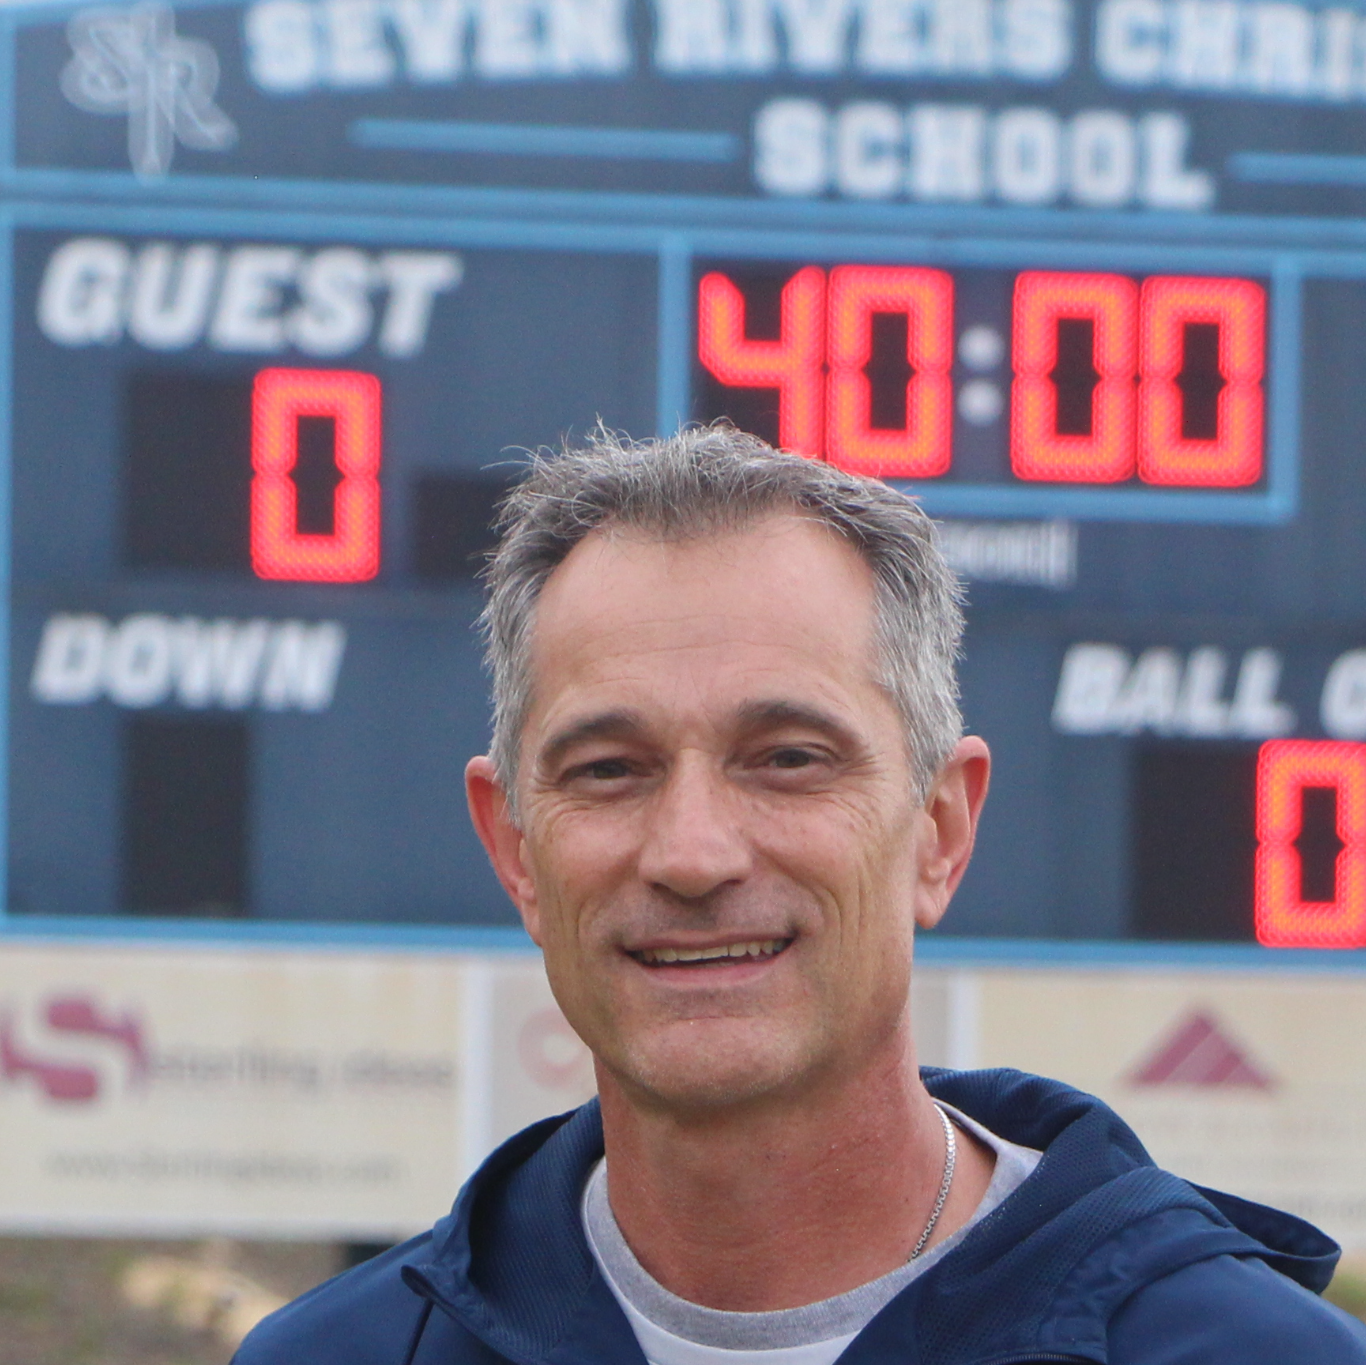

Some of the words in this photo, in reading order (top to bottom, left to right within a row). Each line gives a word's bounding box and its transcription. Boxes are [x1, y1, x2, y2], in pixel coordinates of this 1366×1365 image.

[245, 0, 630, 91] SEVEN
[653, 0, 1073, 79] RIVERS
[753, 96, 1217, 209] SCHOOL
[37, 239, 461, 355] GUEST
[697, 263, 1268, 488] 40:00
[249, 367, 383, 584] 0
[33, 614, 346, 711] DOWN
[1052, 642, 1297, 736] BALL
